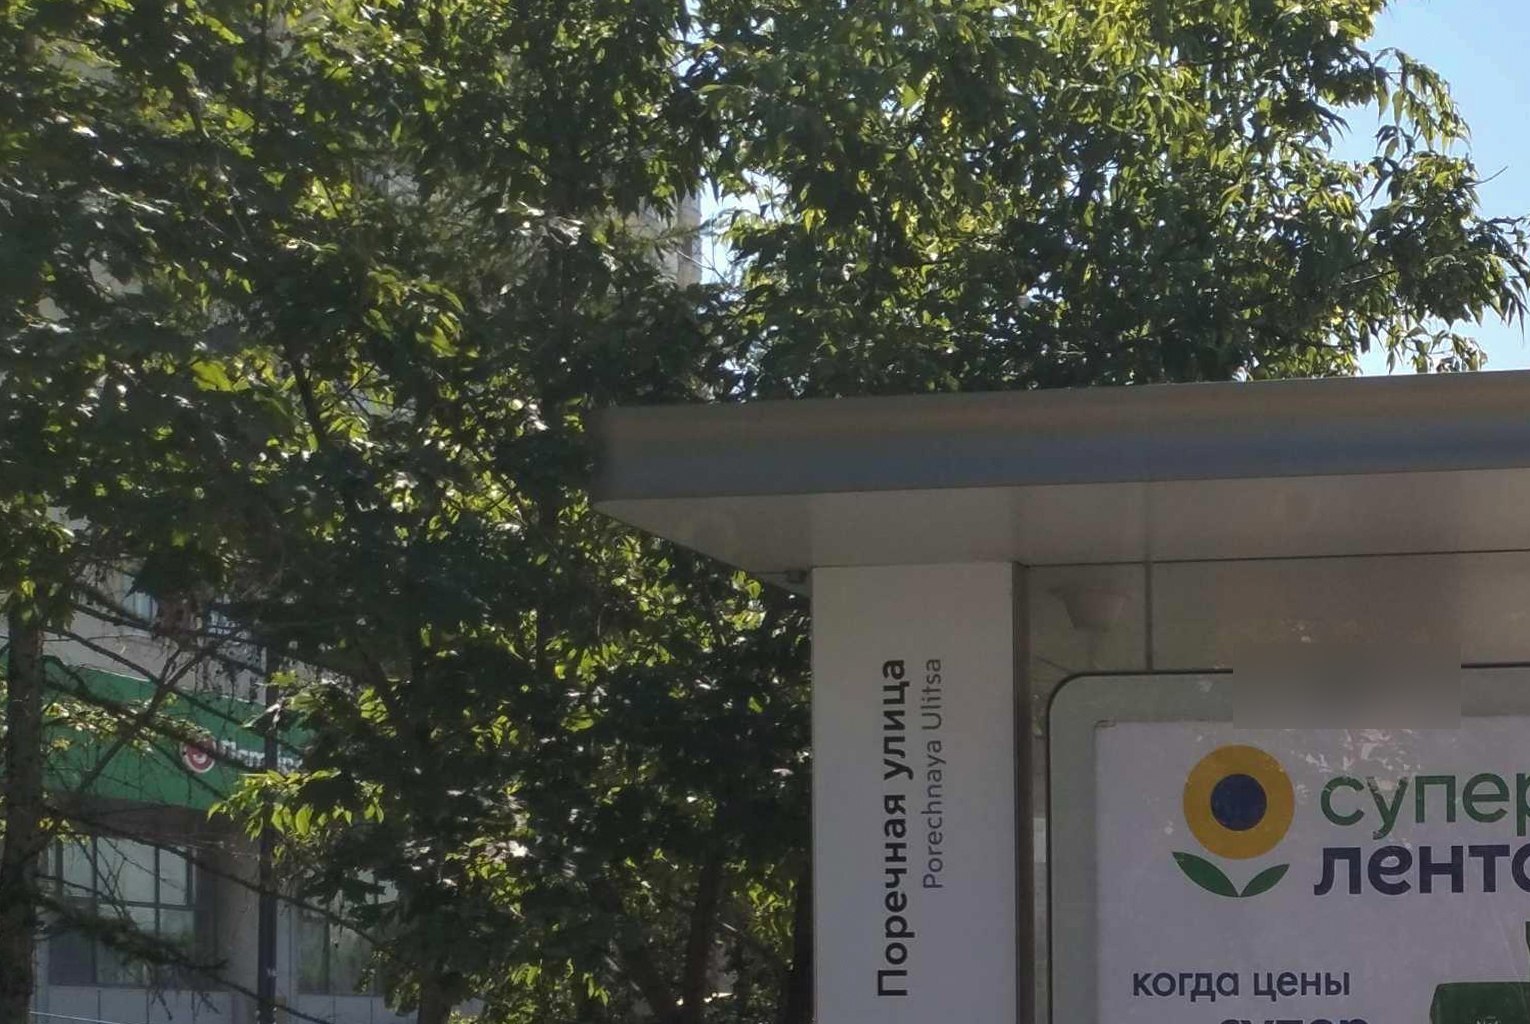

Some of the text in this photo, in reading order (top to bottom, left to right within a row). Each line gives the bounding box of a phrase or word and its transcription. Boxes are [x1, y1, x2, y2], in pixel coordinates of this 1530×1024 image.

[877, 658, 915, 996] Поречная улица
[920, 658, 947, 889] Porechnaya Ulitsa
[1132, 971, 1351, 1003] когда цены
